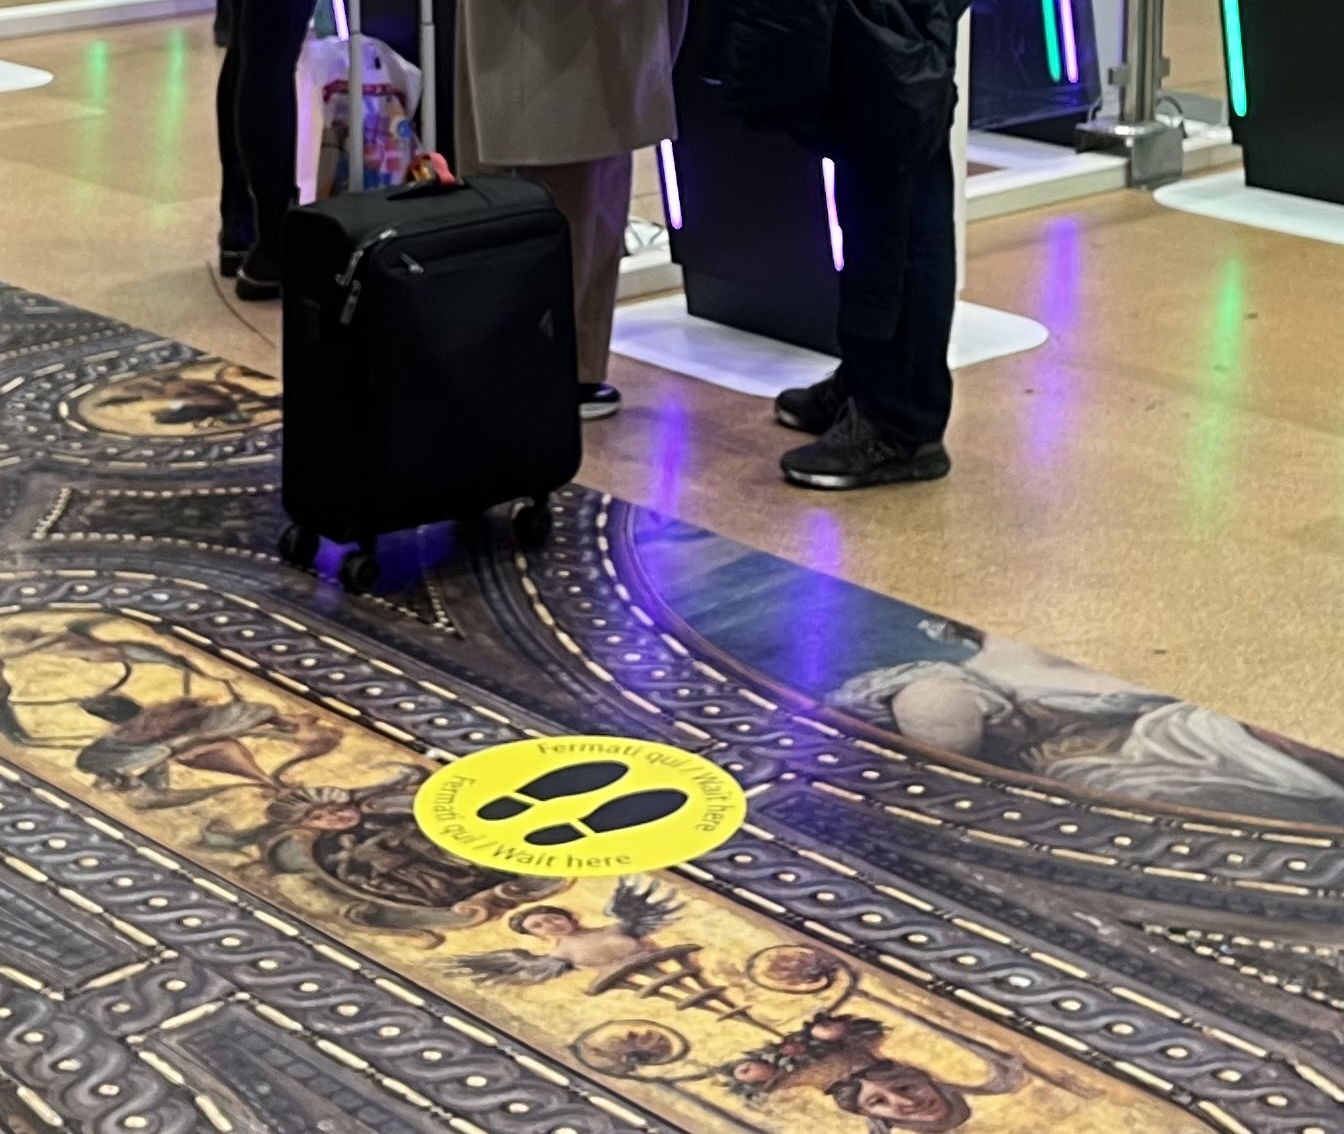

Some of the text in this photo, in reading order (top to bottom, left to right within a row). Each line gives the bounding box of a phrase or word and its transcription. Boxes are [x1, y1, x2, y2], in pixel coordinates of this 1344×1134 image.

[537, 742, 644, 756] Fermati
[645, 751, 691, 768] qui
[691, 771, 733, 802] Wait
[433, 774, 476, 822] Fermati
[493, 844, 558, 867] Wait
[567, 854, 632, 869] here
[695, 804, 737, 832] here
